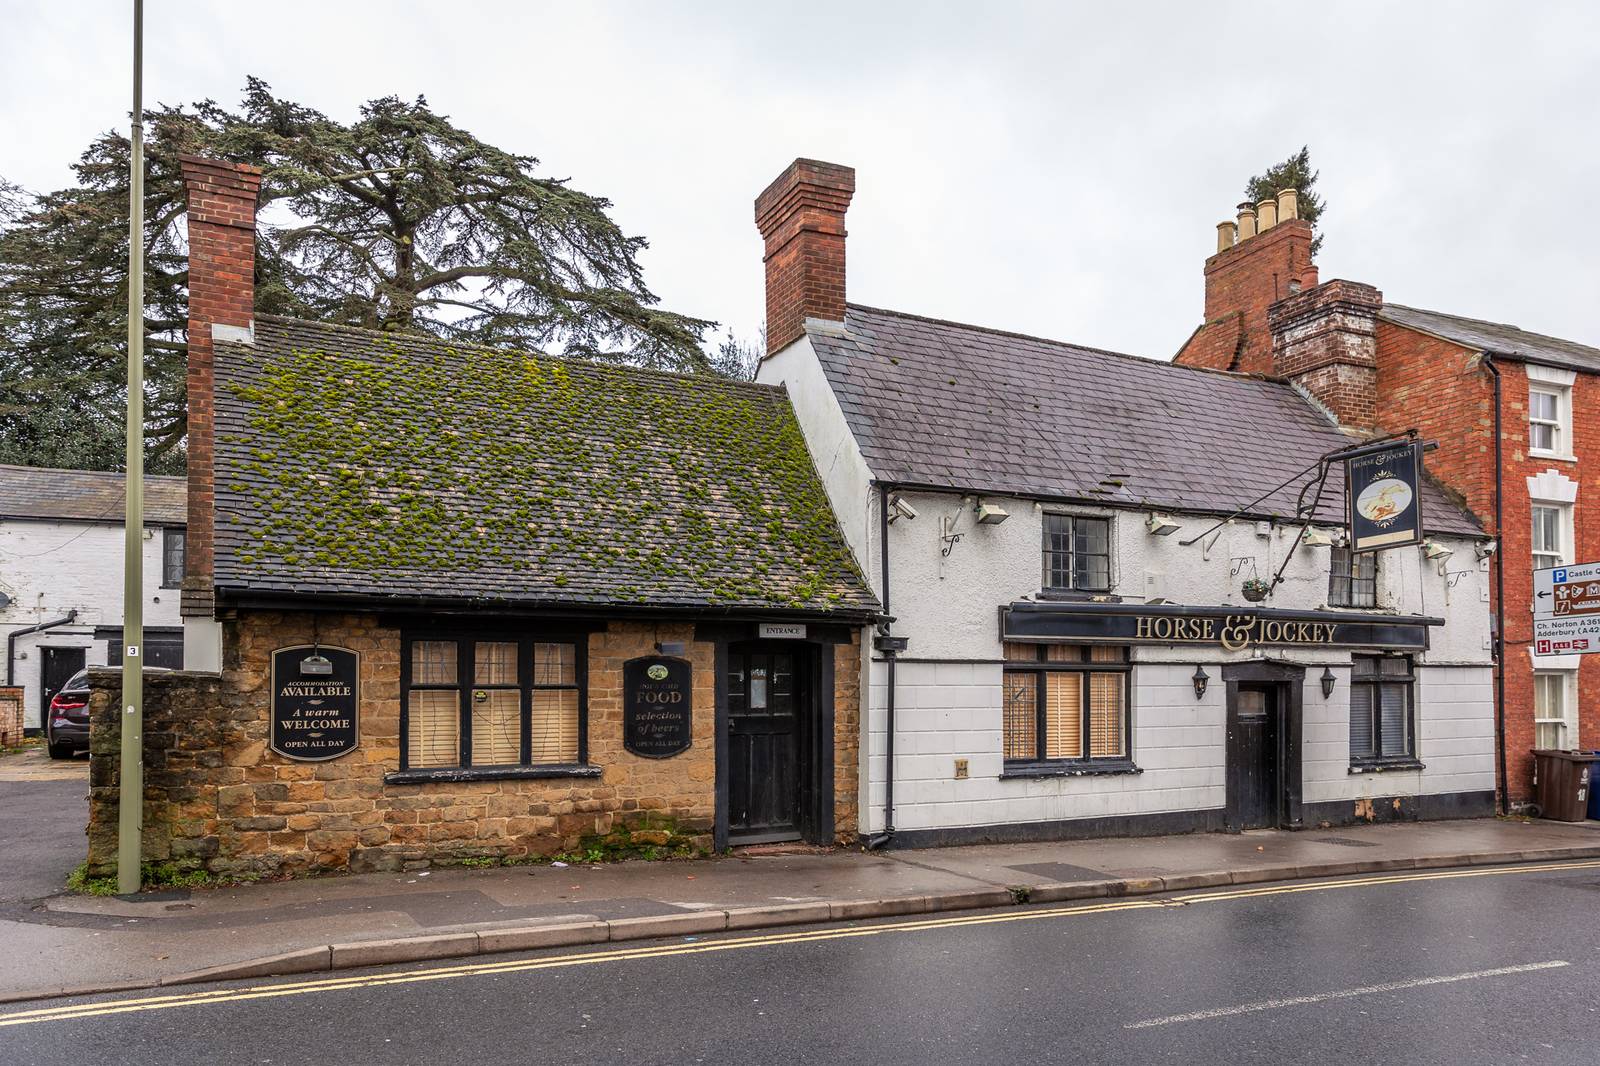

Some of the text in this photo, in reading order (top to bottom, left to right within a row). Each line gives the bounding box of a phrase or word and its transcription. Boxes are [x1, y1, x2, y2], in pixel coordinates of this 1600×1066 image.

[1375, 454, 1386, 465] &
[1386, 449, 1413, 462] JOCKEY
[1556, 571, 1565, 582] P
[1569, 570, 1593, 578] Castle
[1552, 621, 1578, 629] Norton
[766, 627, 800, 635] ENTRANCE
[1135, 616, 1338, 651] HORSE & JOCKEY
[1537, 629, 1575, 637] Adderbury
[130, 647, 136, 655] 3
[280, 687, 351, 697] AVAILABLE
[636, 691, 682, 704] FOOD
[292, 709, 339, 717] A warm
[635, 711, 681, 721] selection
[281, 719, 350, 730] WELCOME
[638, 723, 650, 735] of
[310, 740, 326, 748] ALL
